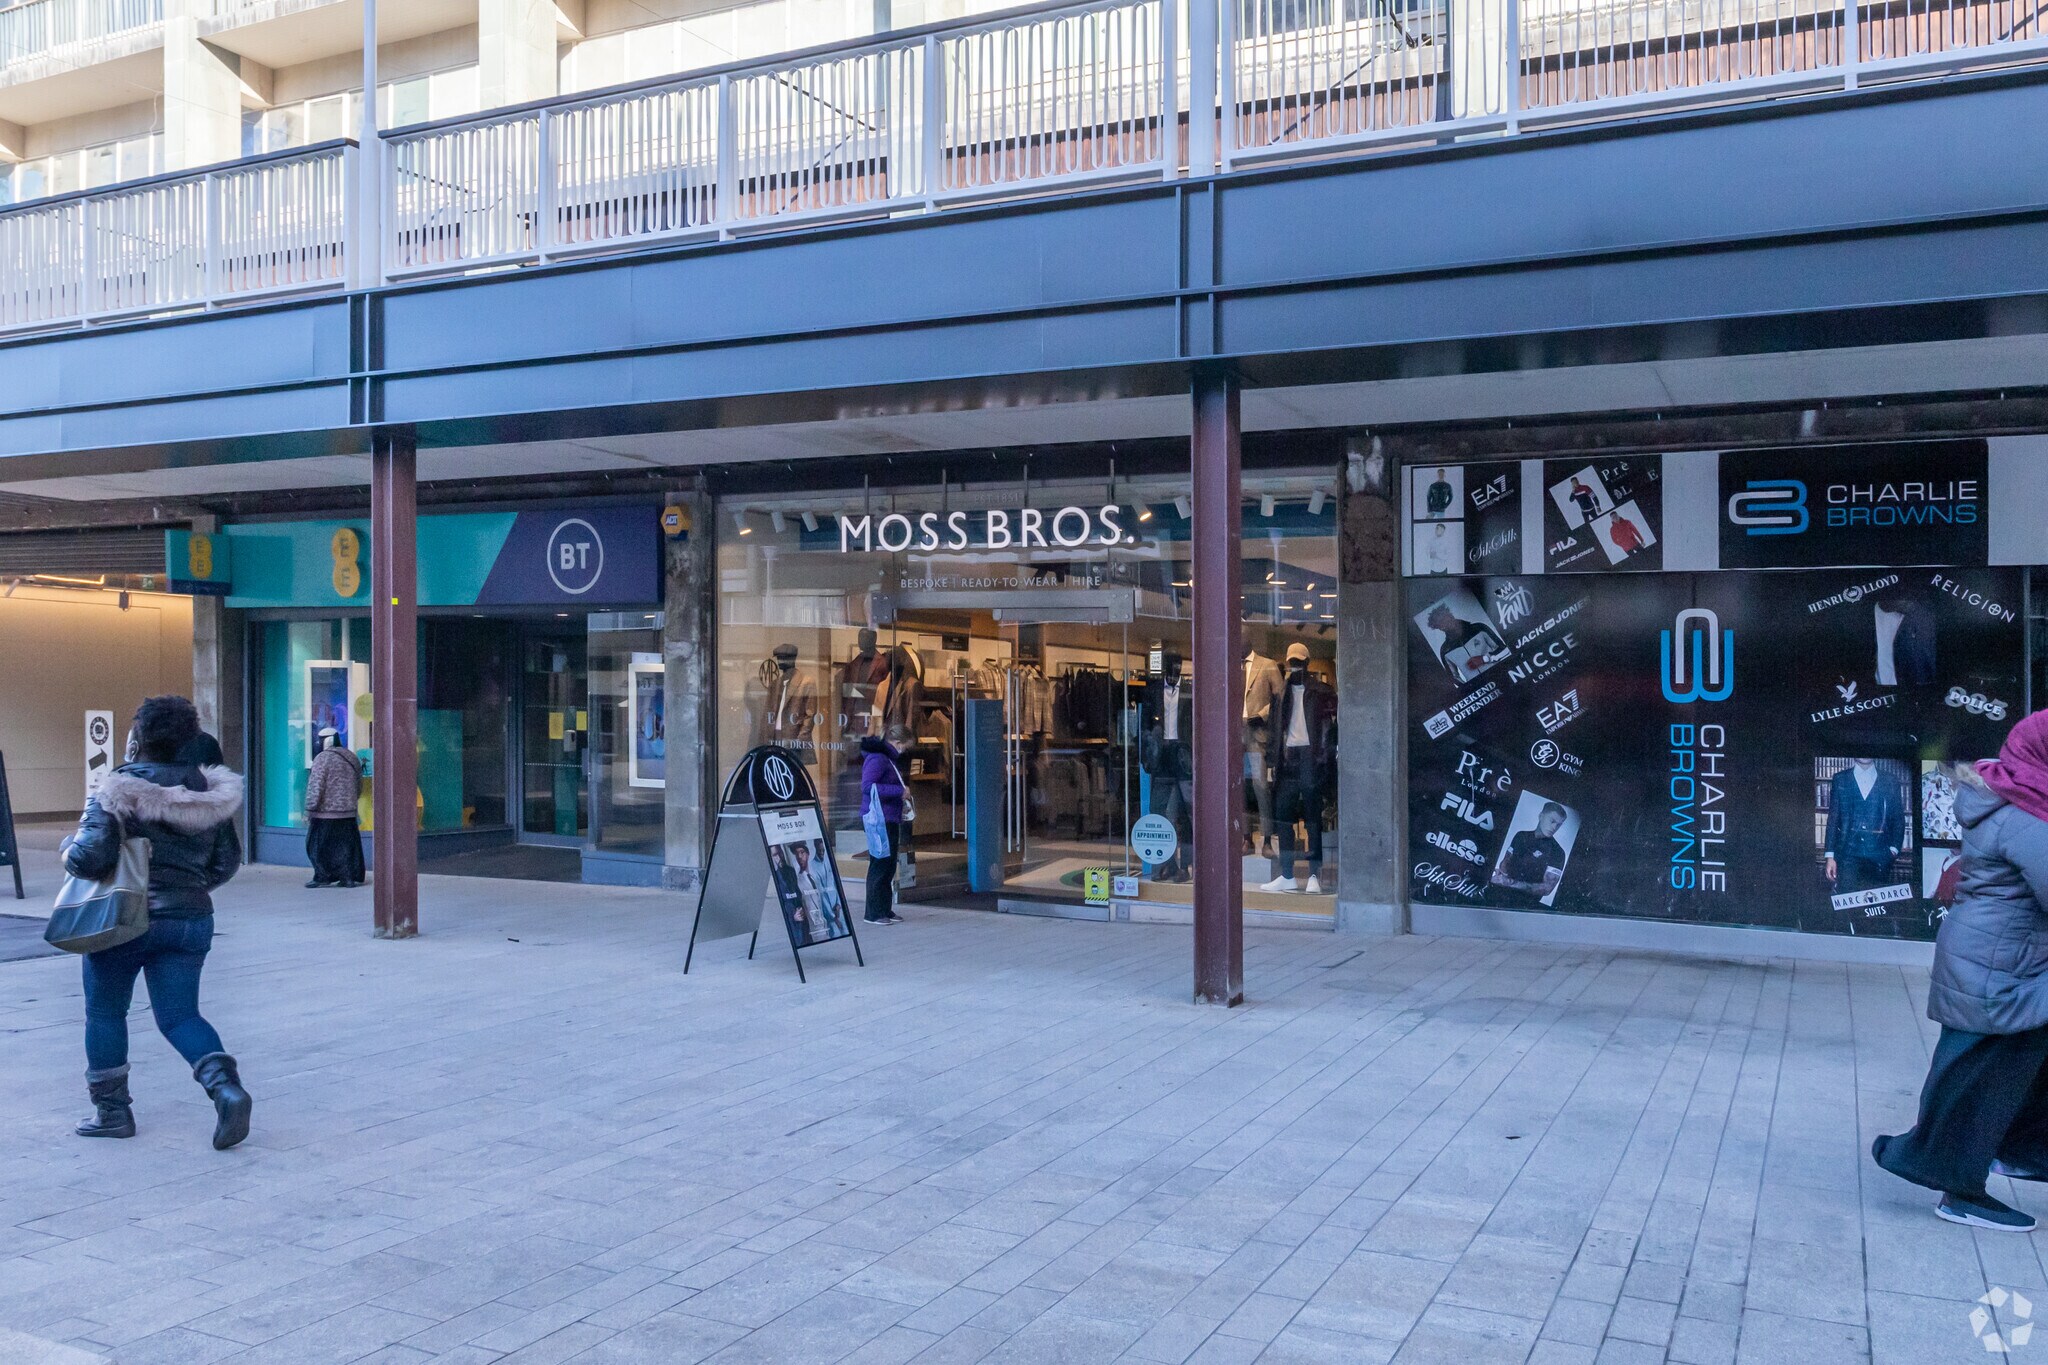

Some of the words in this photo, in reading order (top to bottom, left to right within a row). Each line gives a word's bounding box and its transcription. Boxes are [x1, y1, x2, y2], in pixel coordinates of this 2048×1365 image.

[1470, 474, 1507, 506] EA7
[1826, 480, 1978, 504] CHARLIE
[665, 514, 678, 526] ADT
[1826, 504, 1977, 527] BROWNS
[841, 511, 968, 553] MOSS
[987, 505, 1135, 549] BROS.
[560, 542, 590, 570] BT
[1549, 536, 1577, 556] FILA
[900, 577, 948, 589] BESPOKE
[961, 576, 1058, 588] READY-TO-WEAR
[1072, 575, 1101, 587] HIRE
[1808, 594, 1843, 613] HENRI
[1863, 574, 1899, 594] LLOYD
[1515, 625, 1545, 649] JACK
[1508, 632, 1580, 684] NICCE
[1533, 658, 1570, 684] LONDON
[1449, 681, 1497, 714] WEEKEND
[1453, 688, 1503, 723] OFFENDER
[1536, 688, 1580, 729] EA7
[1811, 707, 1842, 722] LYLE
[1843, 704, 1855, 715] &
[1857, 694, 1897, 712] SCOTT
[1949, 691, 2002, 716] POLICE
[820, 741, 846, 751] CODE
[1455, 750, 1512, 792] Prè
[1559, 762, 1582, 777] KING
[1562, 752, 1584, 767] GYM
[1461, 778, 1497, 798] London
[1441, 792, 1494, 831] FILA
[1670, 723, 1695, 890] BROWNS
[1700, 724, 1725, 892] CHARLIE
[777, 822, 793, 830] MOSS
[1136, 832, 1171, 840] APPOINTMENT
[1425, 831, 1486, 866] ellesse
[1834, 895, 1860, 908] MARC
[1881, 887, 1911, 900] DARCY
[1864, 905, 1887, 918] SUITS
